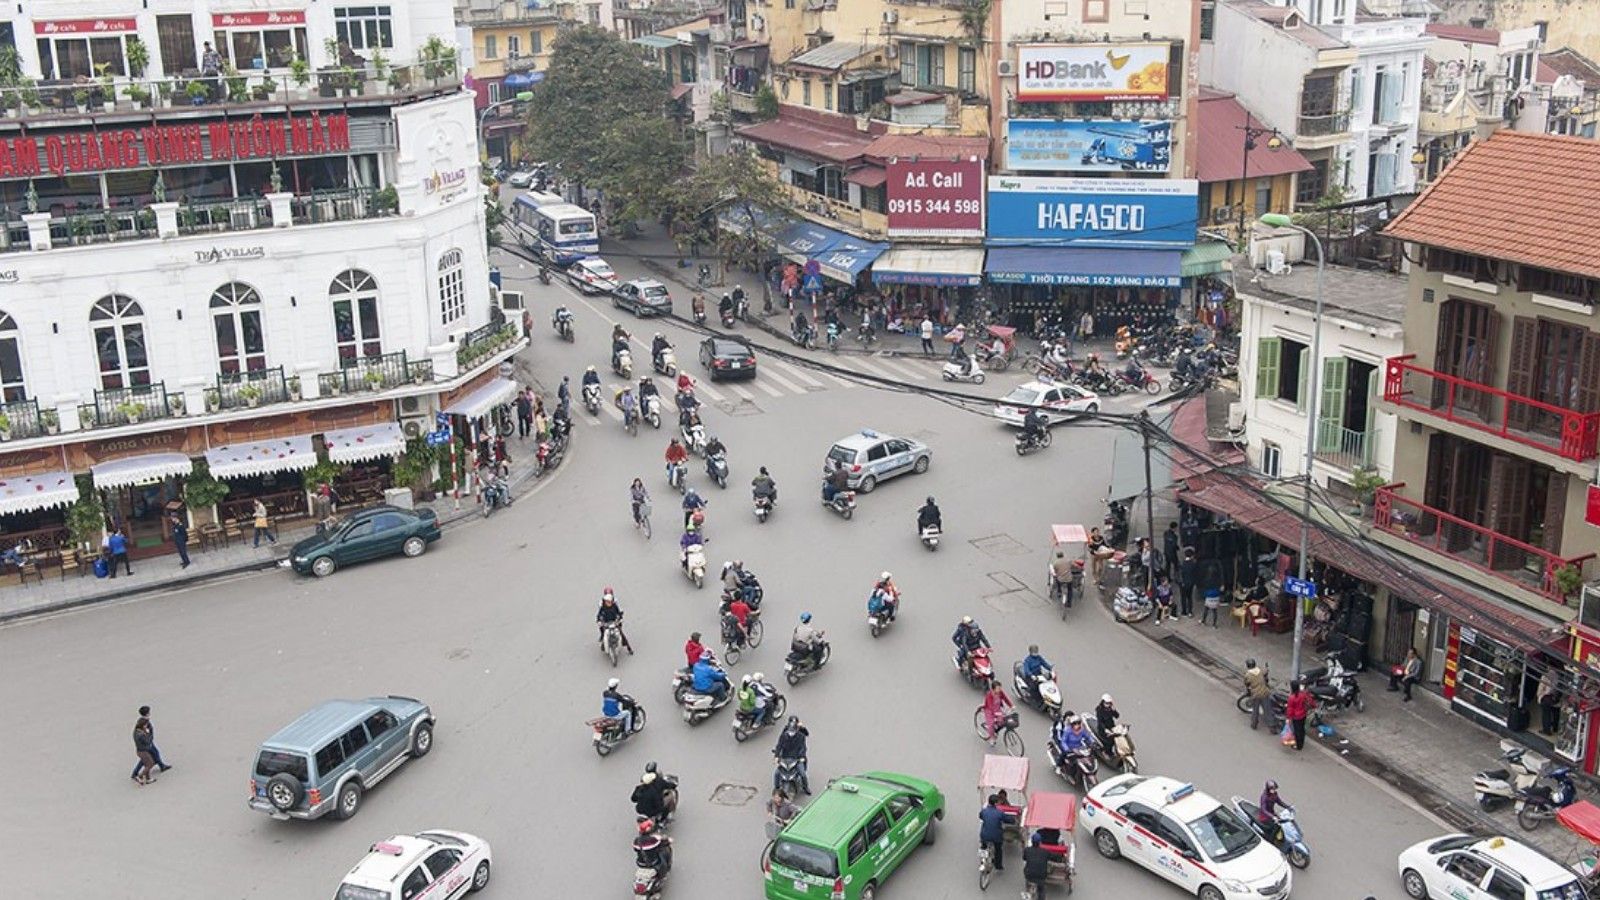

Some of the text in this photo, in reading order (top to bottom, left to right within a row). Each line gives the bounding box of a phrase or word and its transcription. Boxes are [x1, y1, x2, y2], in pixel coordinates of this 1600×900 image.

[1025, 60, 1107, 79] HDBank
[45, 128, 140, 177] QUANG
[141, 123, 204, 163] VINH
[208, 112, 288, 160] MUÔN
[291, 110, 350, 155] NĂM
[905, 172, 962, 188] Ad. Call
[888, 199, 980, 213] 0915 344 598
[1038, 203, 1145, 231] HAFASCO
[829, 252, 857, 268] VISA
[1056, 274, 1089, 285] TRANG
[1093, 276, 1112, 285] 102
[1114, 275, 1142, 286] HÀNG
